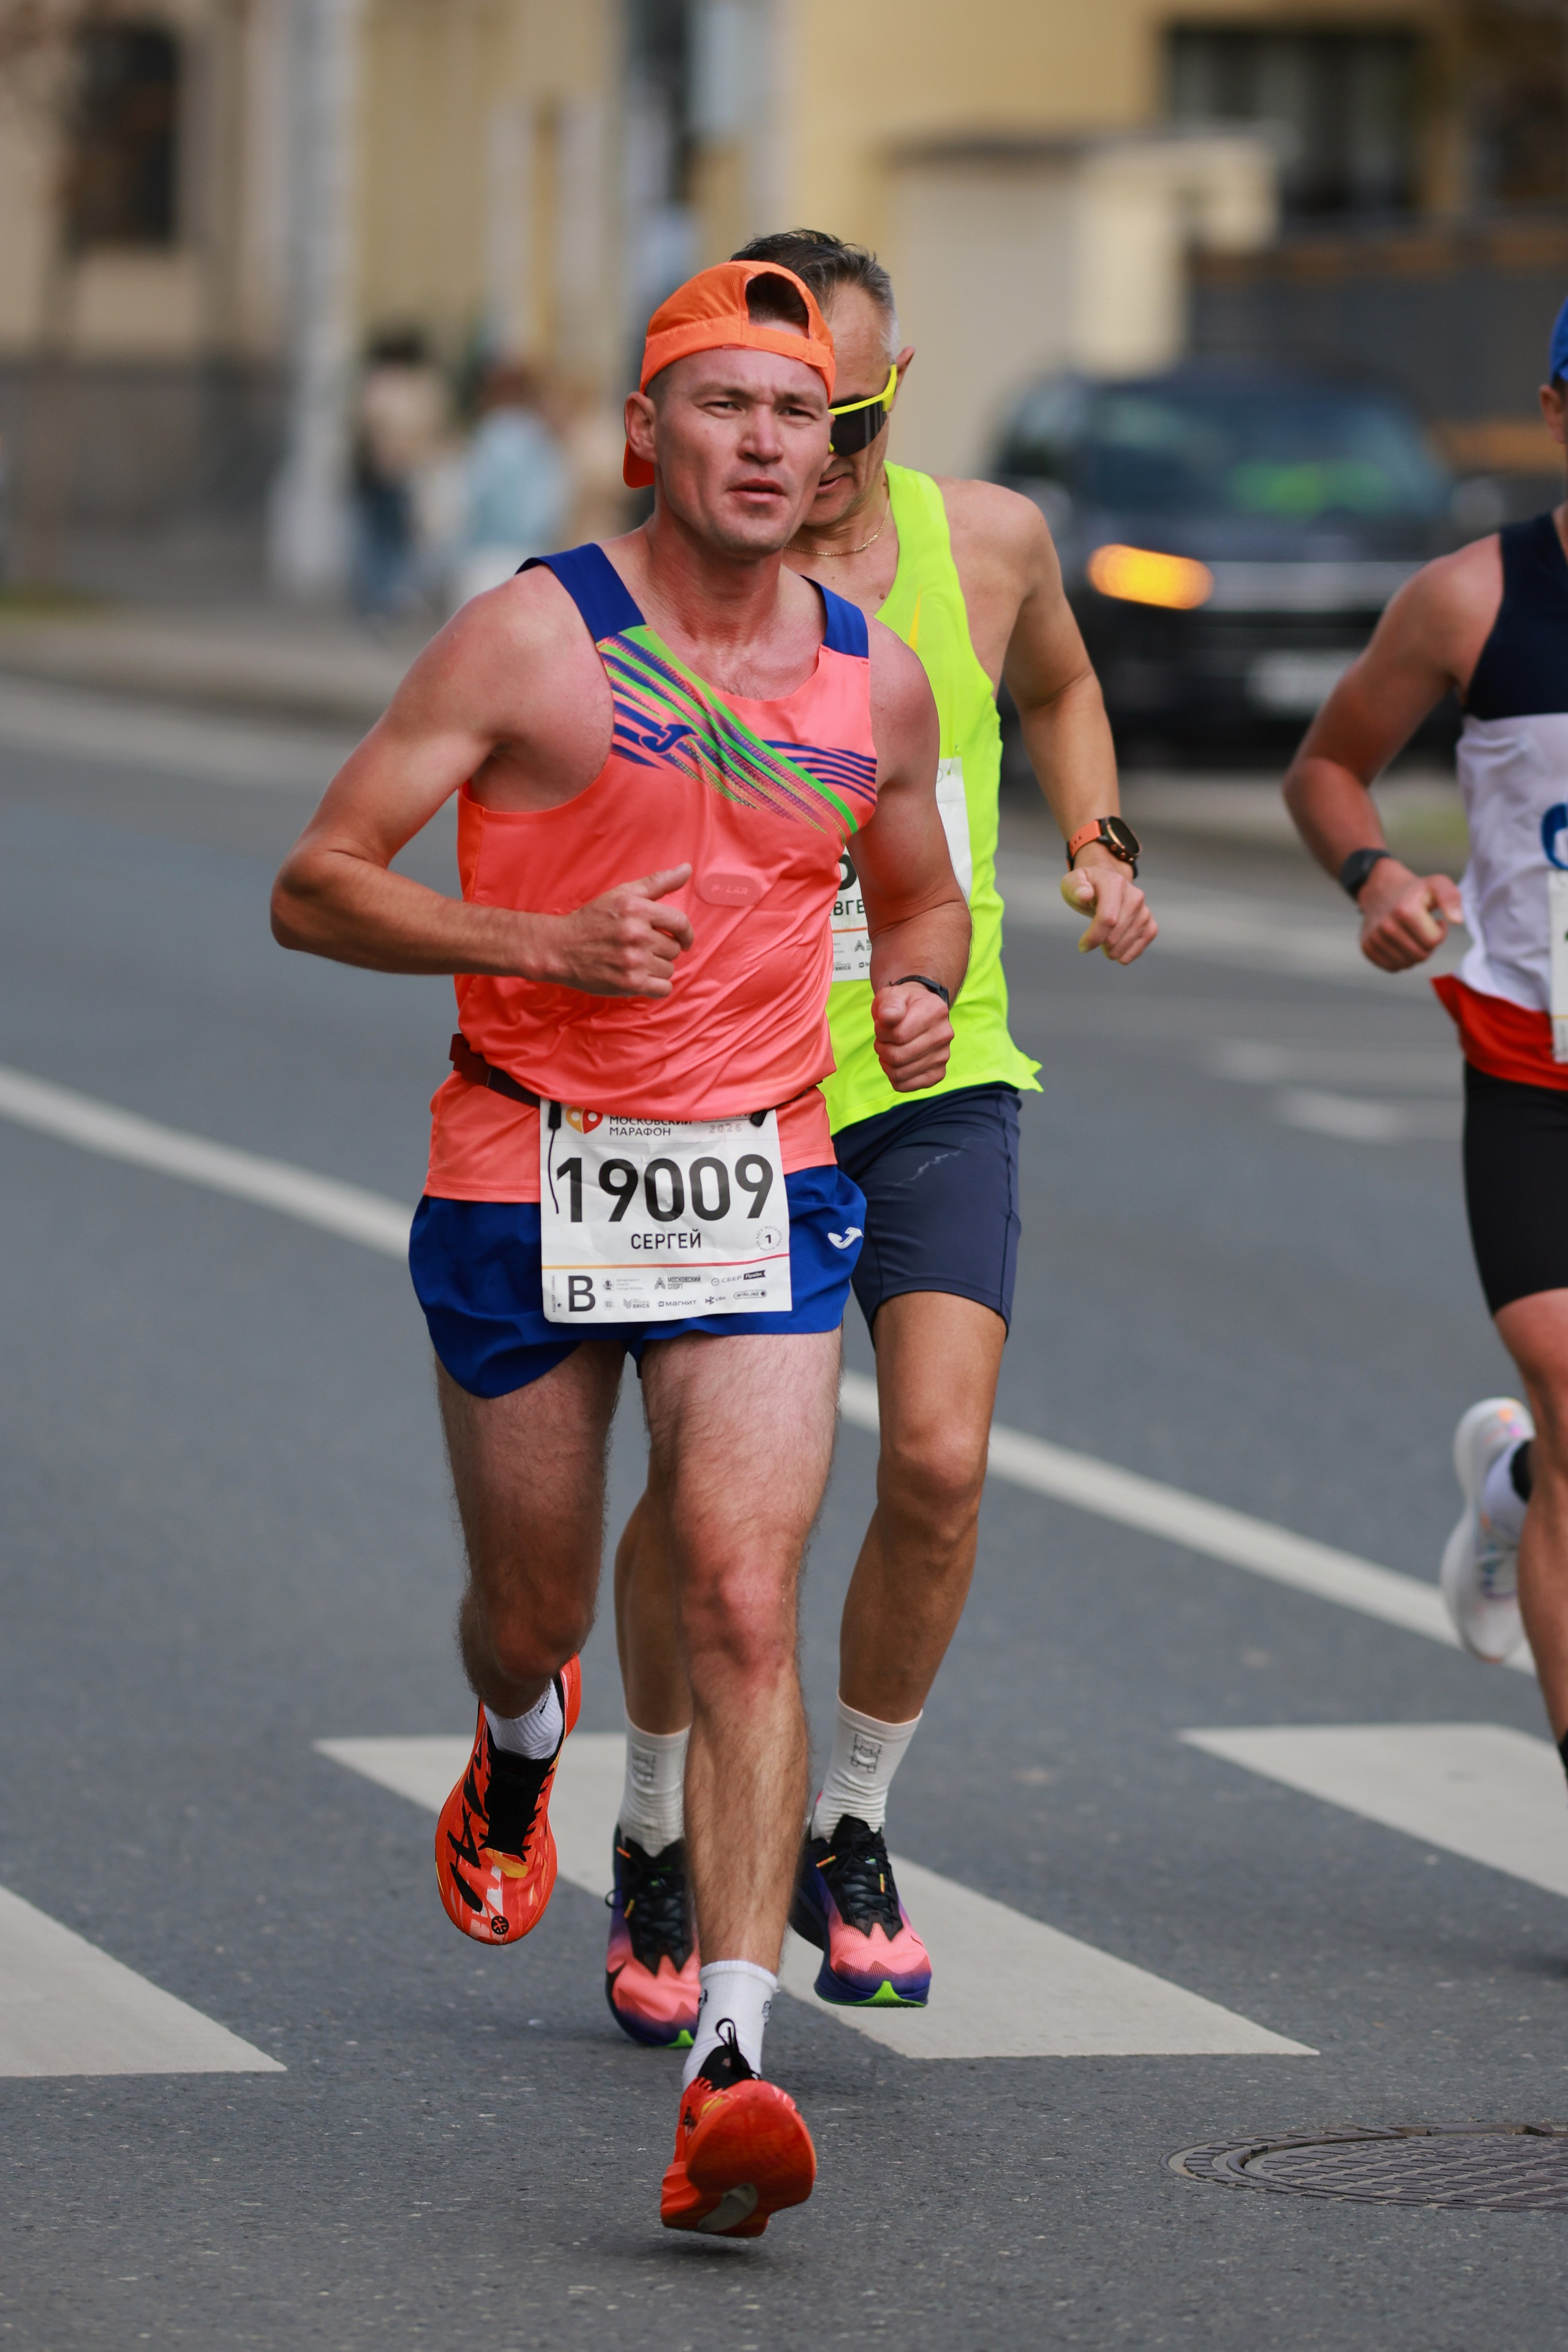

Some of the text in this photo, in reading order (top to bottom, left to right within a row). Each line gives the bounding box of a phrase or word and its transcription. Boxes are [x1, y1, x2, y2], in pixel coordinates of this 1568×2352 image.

[830, 898, 865, 916] ВГЕ
[609, 1127, 671, 1136] МАРАФОН
[557, 1154, 774, 1223] 19009
[631, 1229, 702, 1250] СЕРГЕЙ
[766, 1234, 771, 1244] 1
[668, 1275, 701, 1283] МОСКОВСКИЙ
